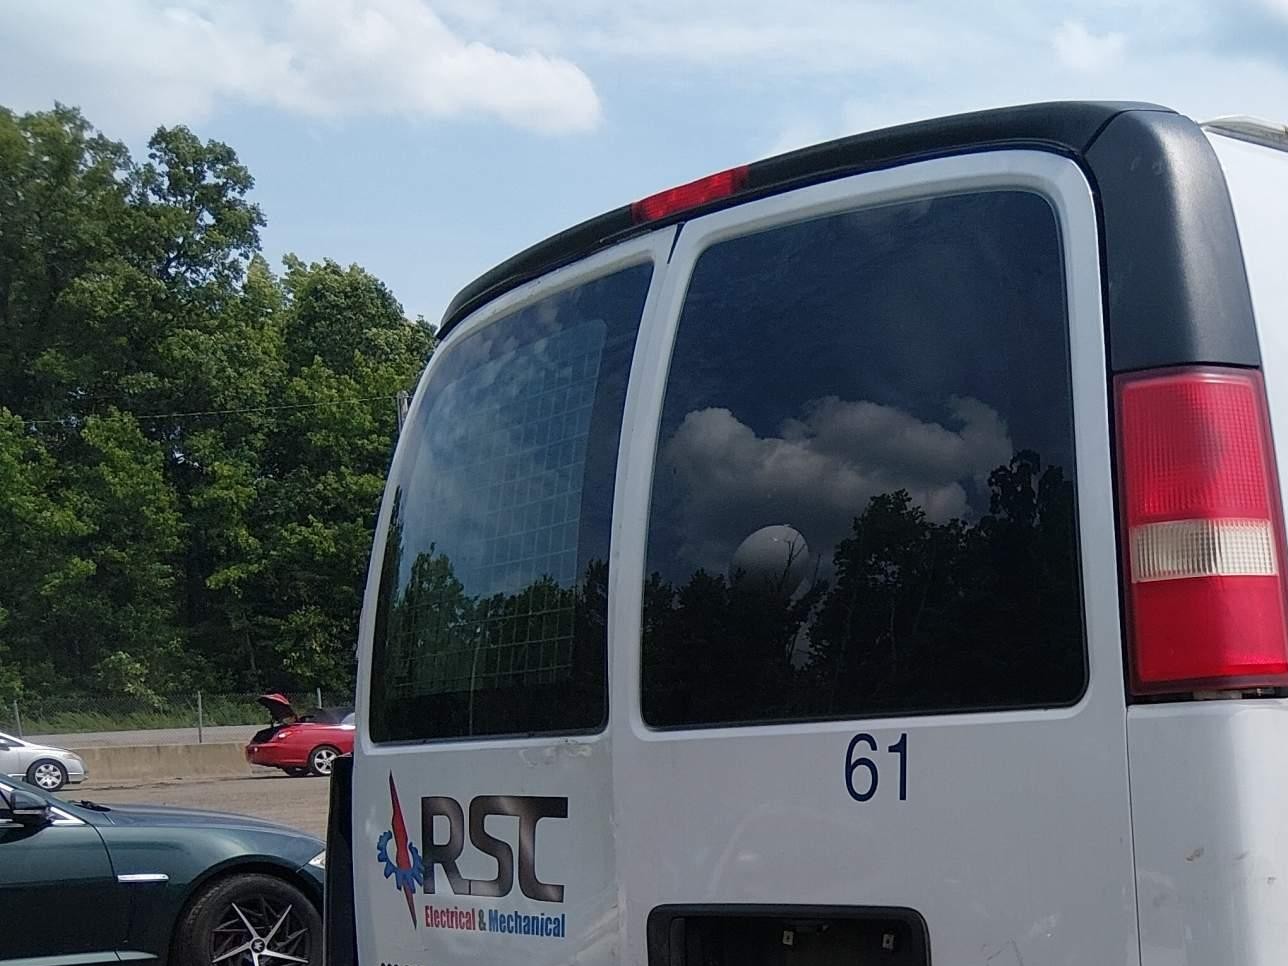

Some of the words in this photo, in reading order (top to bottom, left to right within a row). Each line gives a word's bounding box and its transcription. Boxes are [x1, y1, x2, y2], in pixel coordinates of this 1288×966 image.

[844, 732, 907, 802] 61
[424, 905, 476, 931] Electrical
[478, 909, 487, 932] &
[488, 909, 566, 938] Mechanical
